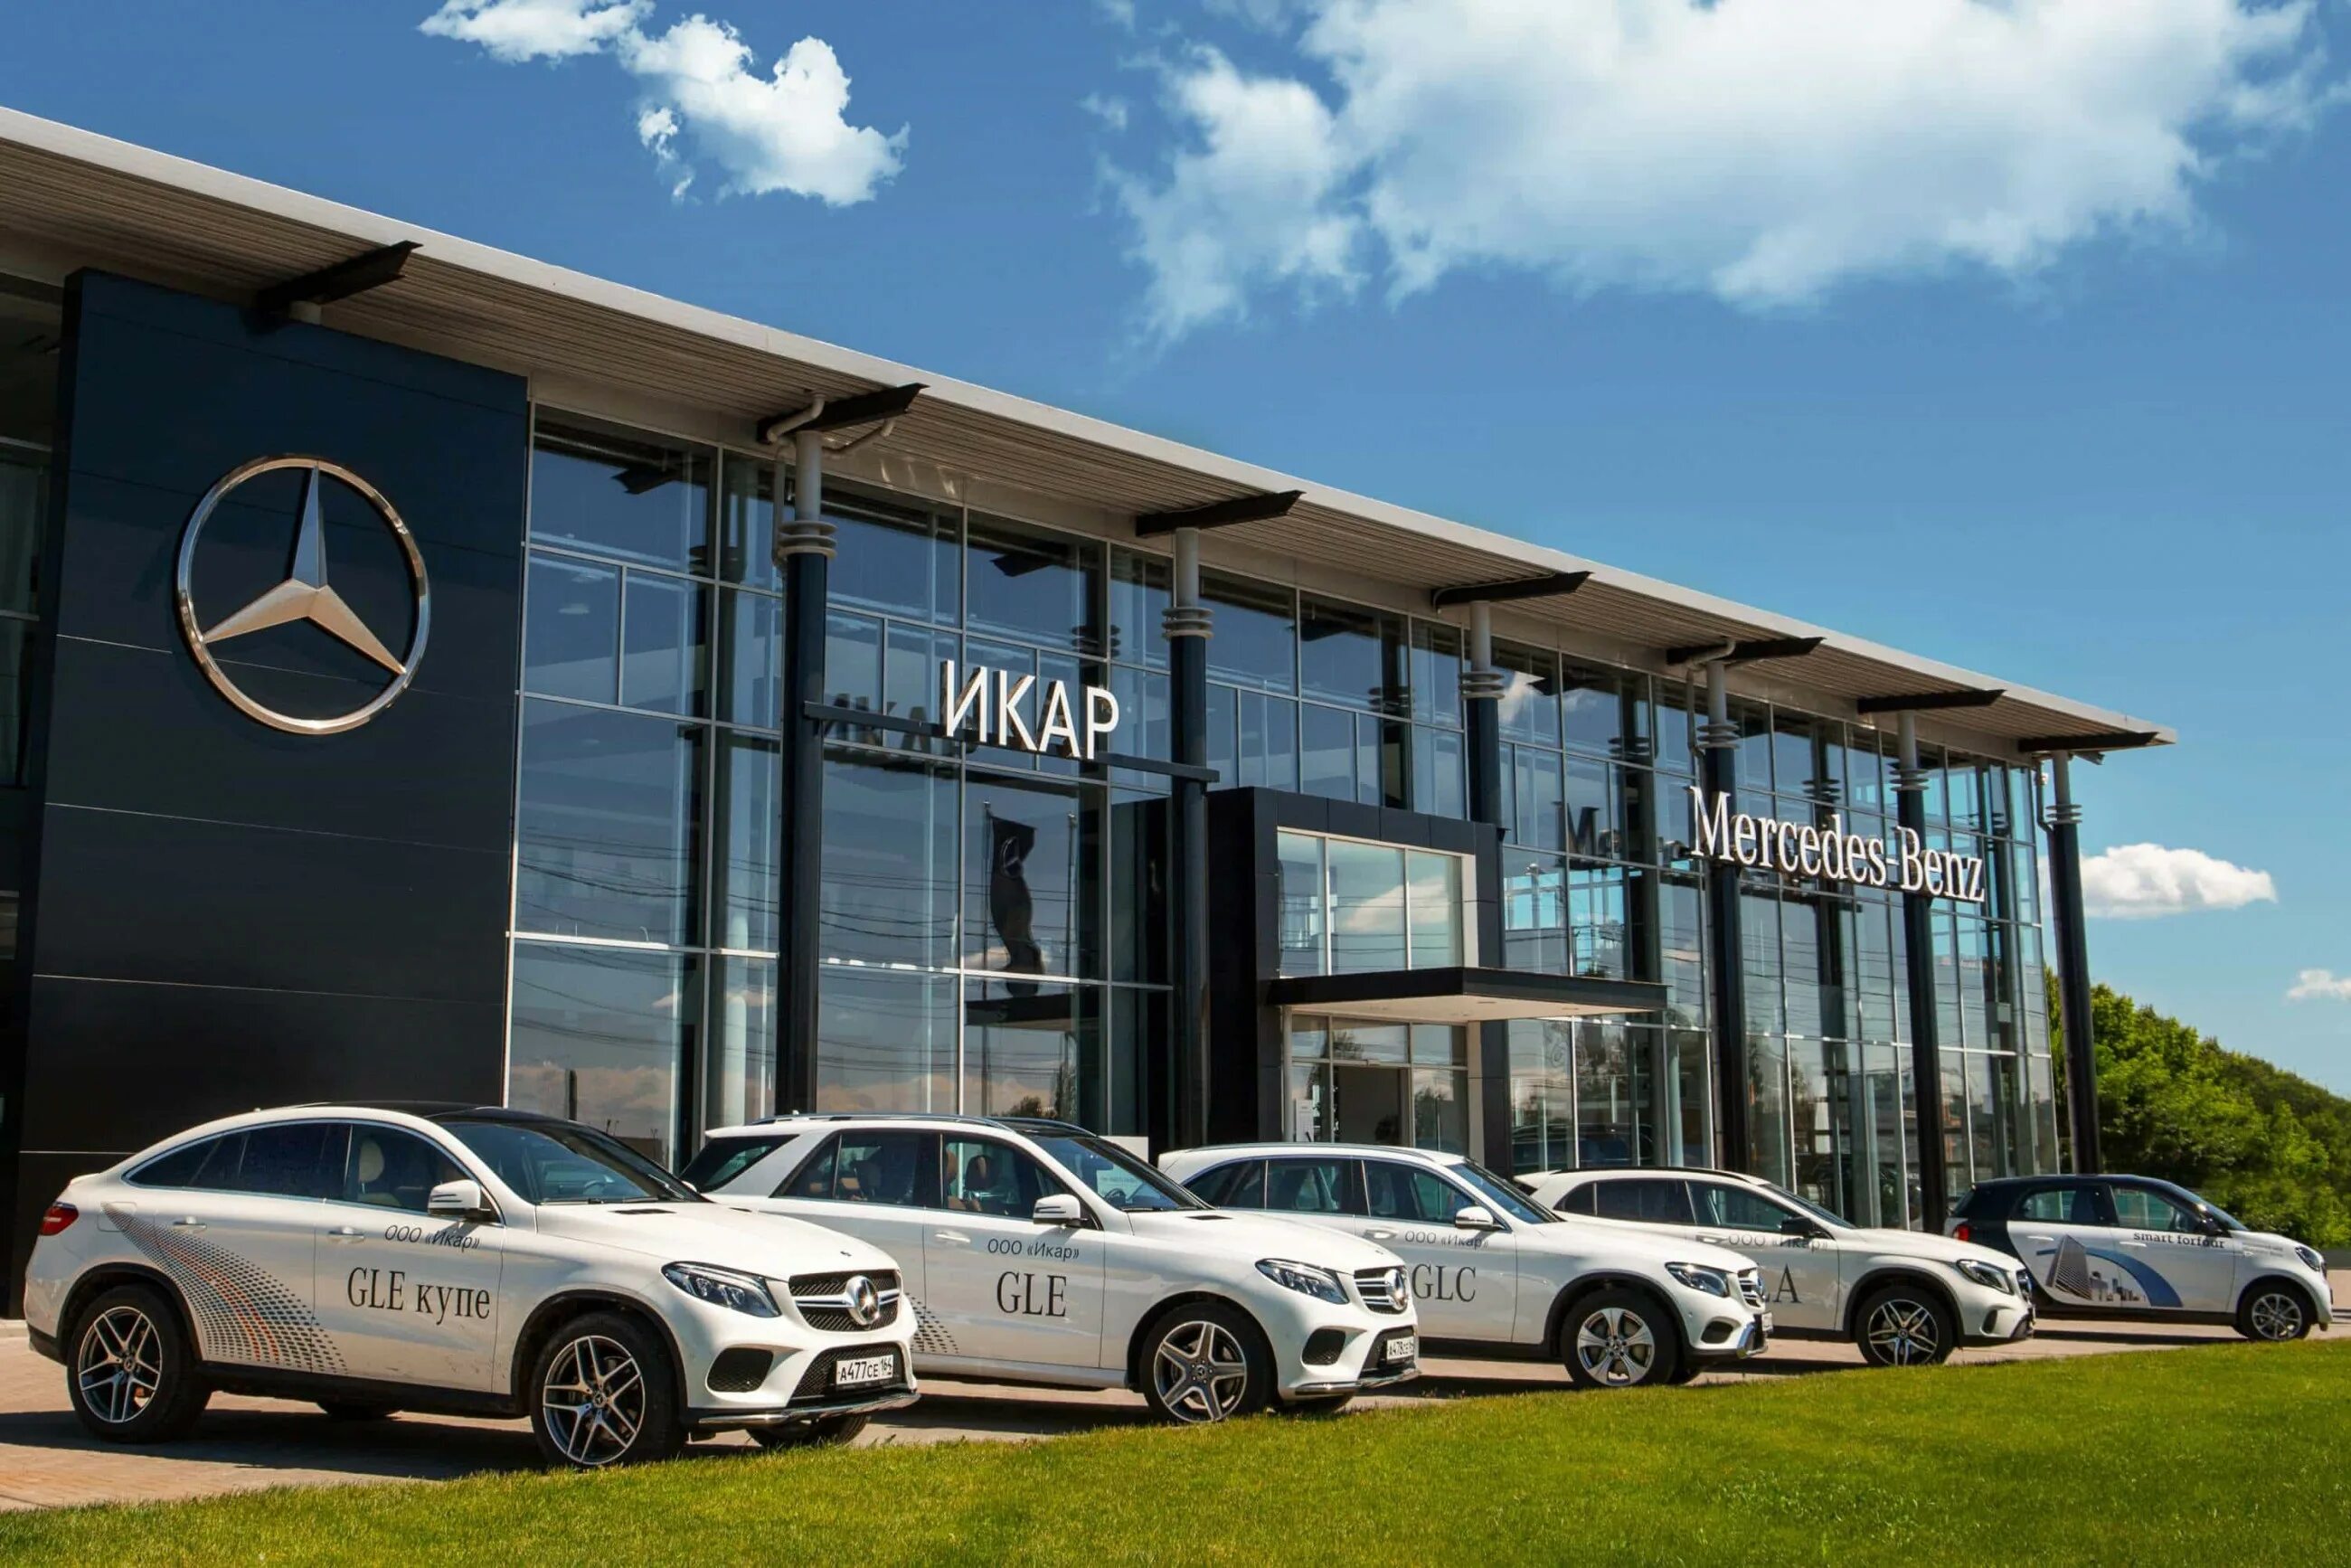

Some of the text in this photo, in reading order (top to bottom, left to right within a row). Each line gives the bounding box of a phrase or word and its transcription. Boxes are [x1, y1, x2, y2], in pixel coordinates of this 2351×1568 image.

[941, 659, 1119, 760] ИКАР
[1688, 785, 1986, 902] Mercedes-Benz
[384, 1224, 422, 1243] ООО
[987, 1238, 1080, 1262] ООО «Икар»
[1405, 1231, 1437, 1244] ООО
[2134, 1233, 2225, 1249] smart forfour
[347, 1267, 491, 1326] GLE купе
[996, 1270, 1067, 1318] GLE
[1412, 1263, 1476, 1303] GLC
